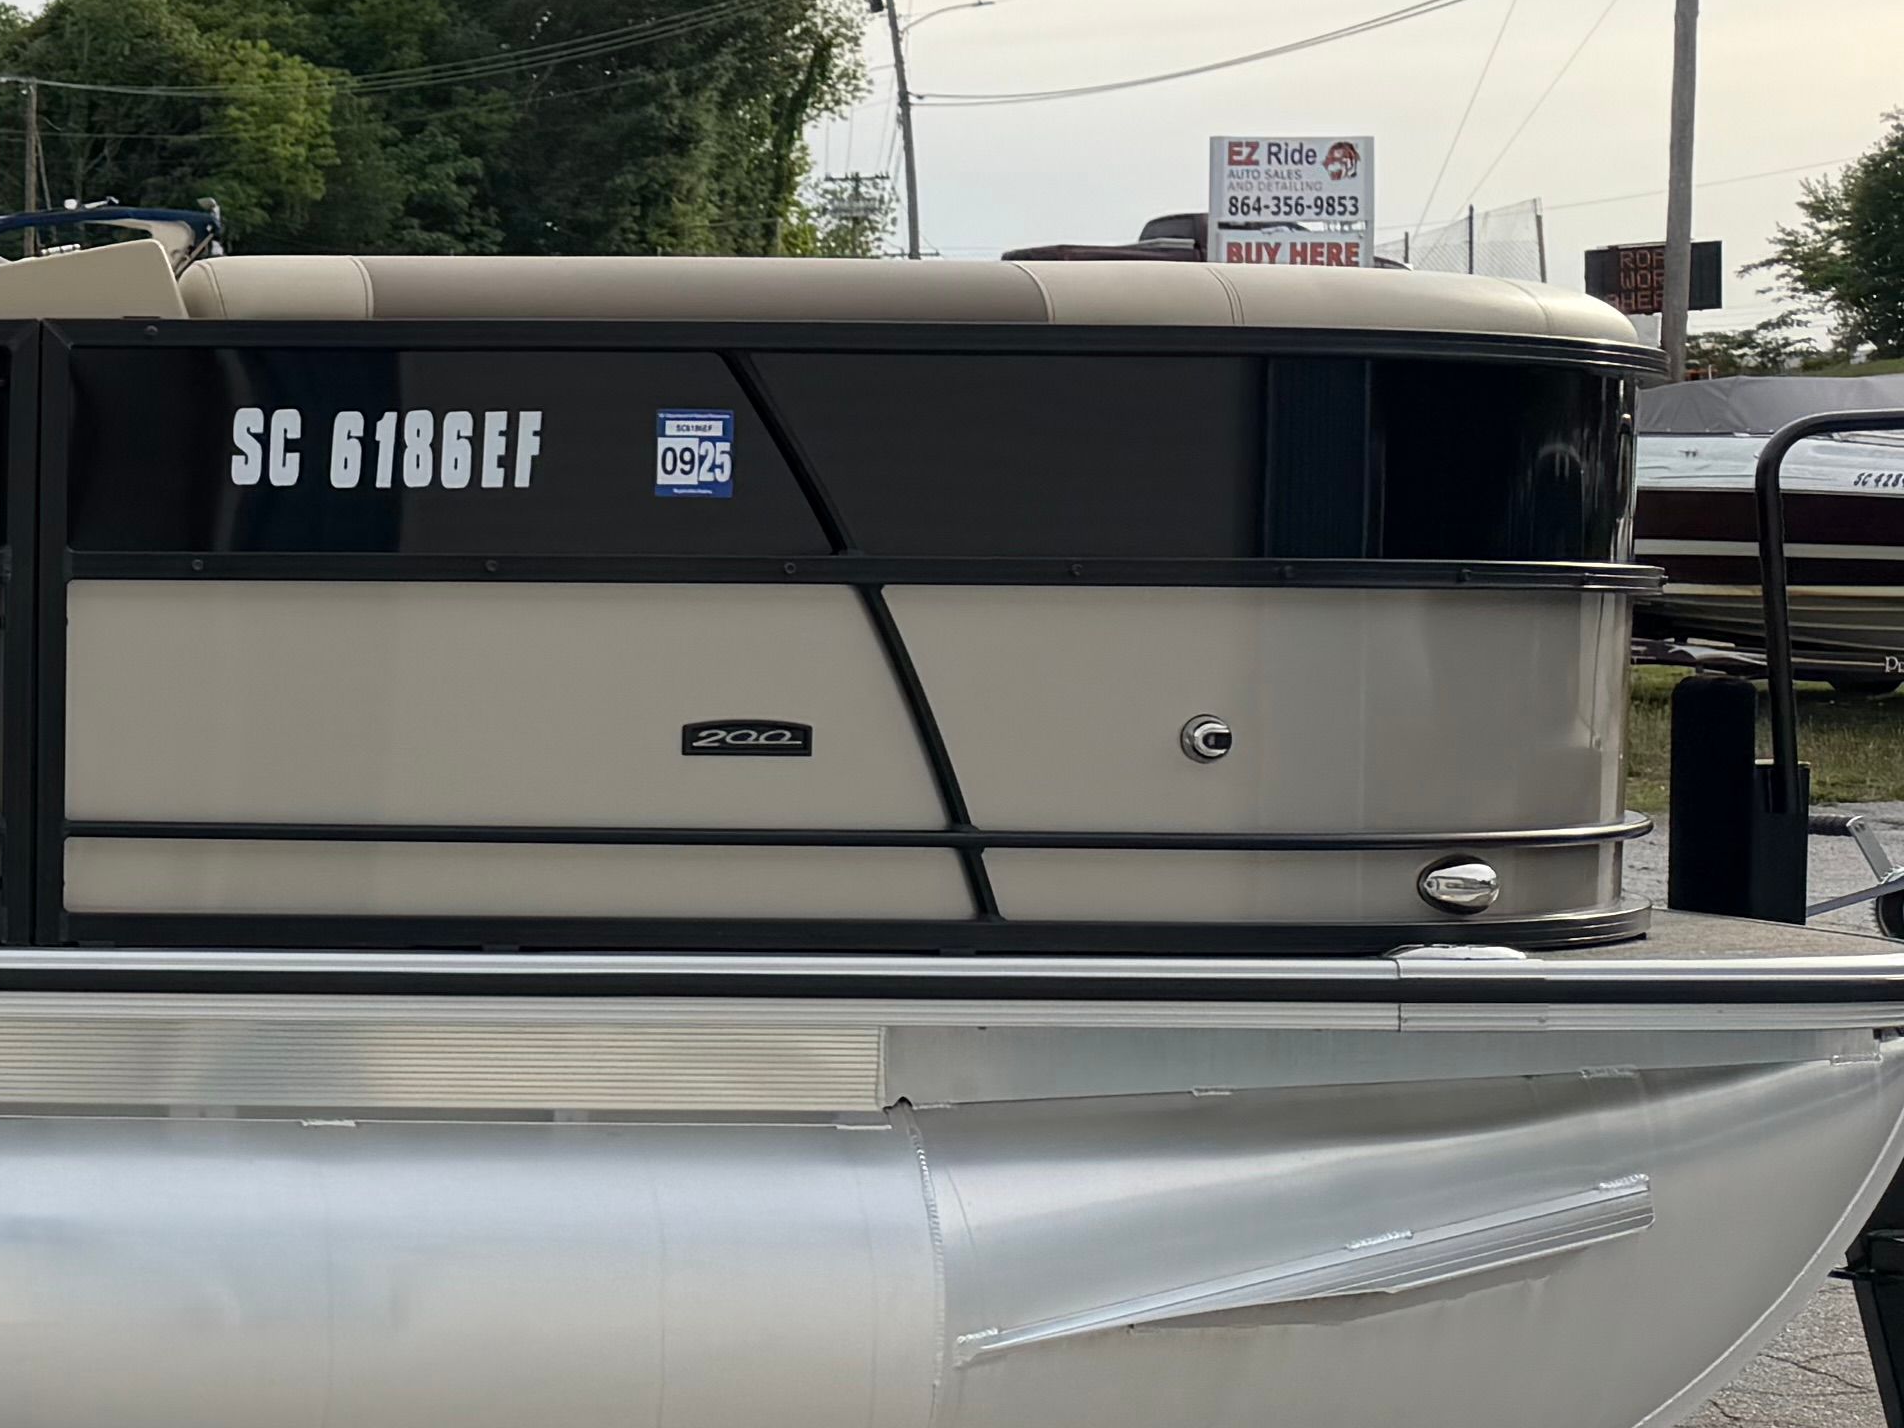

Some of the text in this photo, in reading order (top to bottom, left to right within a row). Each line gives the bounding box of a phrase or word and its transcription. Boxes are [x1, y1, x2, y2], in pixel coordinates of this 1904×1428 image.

[1228, 141, 1317, 165] EZ Ride
[1228, 169, 1302, 181] AUTO SALES
[1228, 181, 1323, 192] AND DETAILING
[1228, 196, 1359, 216] 864-356-9853
[1226, 242, 1360, 266] BUY HERE
[1620, 249, 1665, 269] ROA
[1621, 270, 1665, 289] WOR
[231, 408, 542, 489] SC 6186EF
[661, 441, 732, 482] 09 25
[1874, 472, 1904, 487] 428
[692, 729, 802, 747] 200
